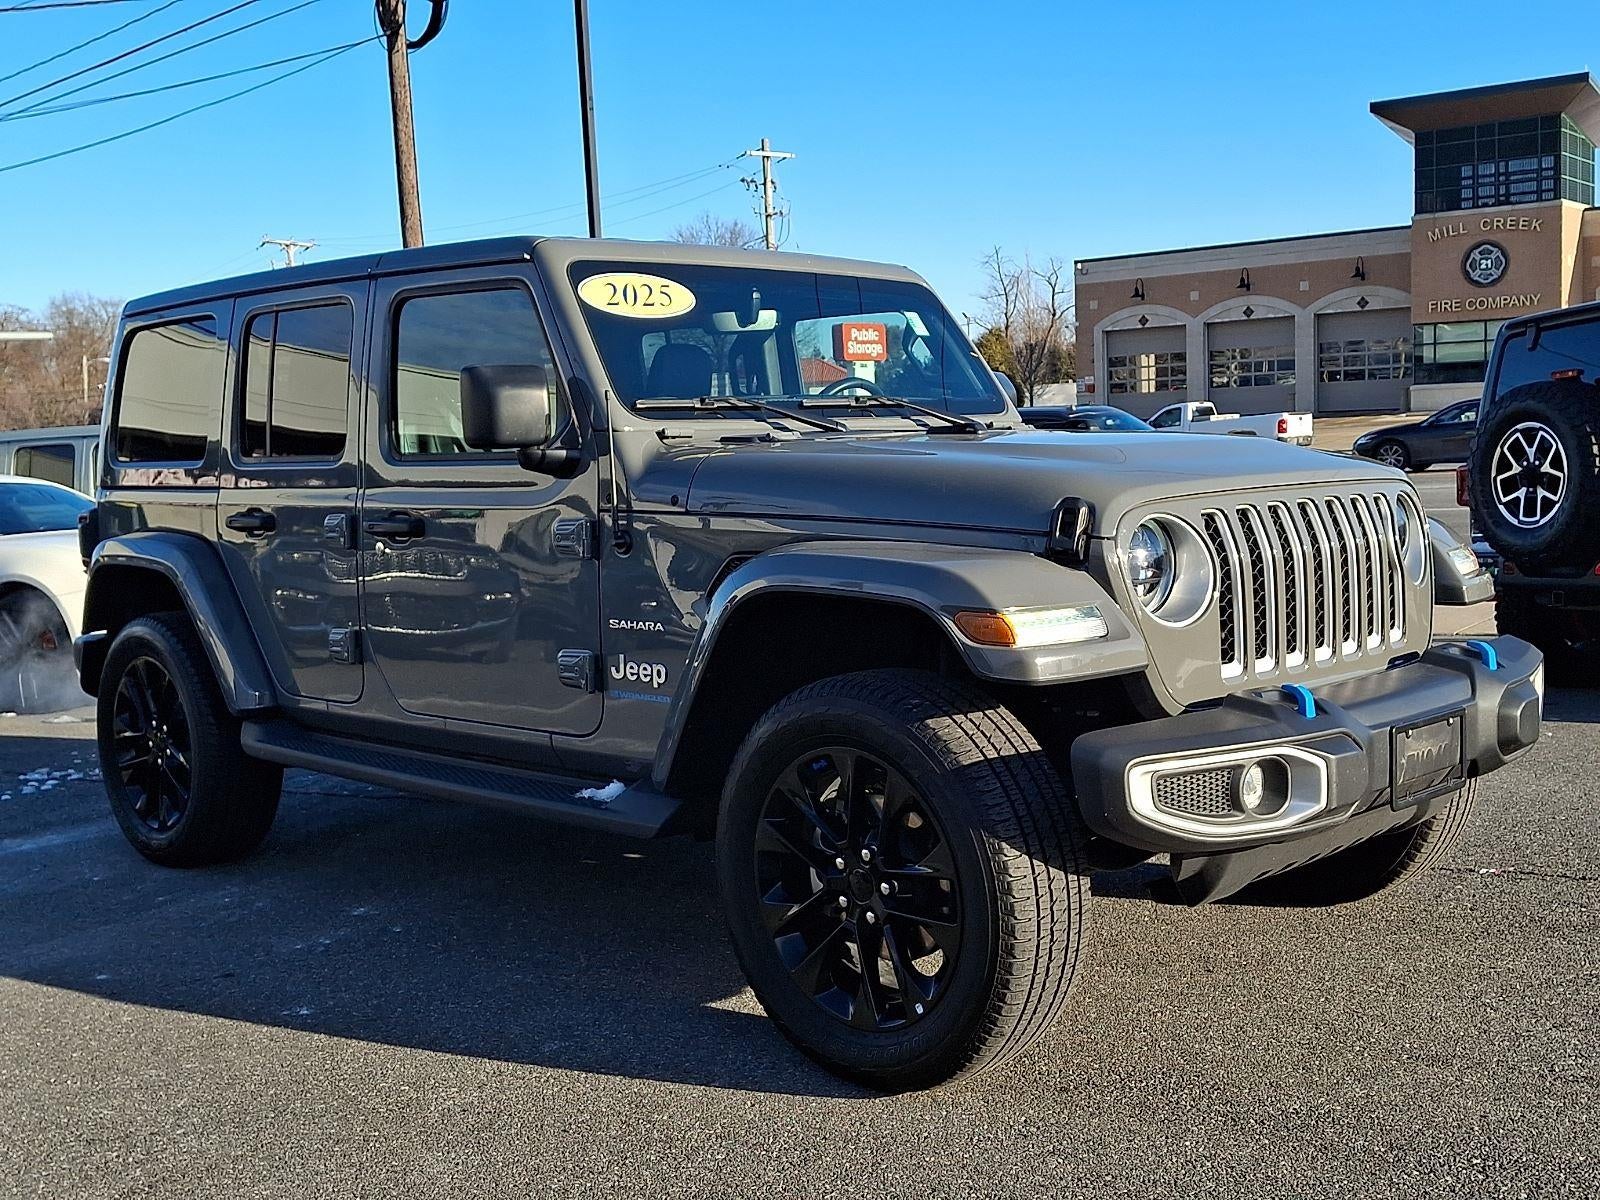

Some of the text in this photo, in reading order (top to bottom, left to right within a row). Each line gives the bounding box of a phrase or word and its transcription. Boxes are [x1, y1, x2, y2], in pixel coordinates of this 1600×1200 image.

[1427, 217, 1542, 242] MILL CREEK
[1480, 259, 1492, 270] 21
[604, 282, 673, 308] 2025
[1428, 293, 1541, 313] FIRE COMPANY
[850, 327, 880, 341] Public
[847, 340, 884, 358] Storage
[609, 619, 664, 631] SAHARA
[610, 653, 666, 688] Jeep
